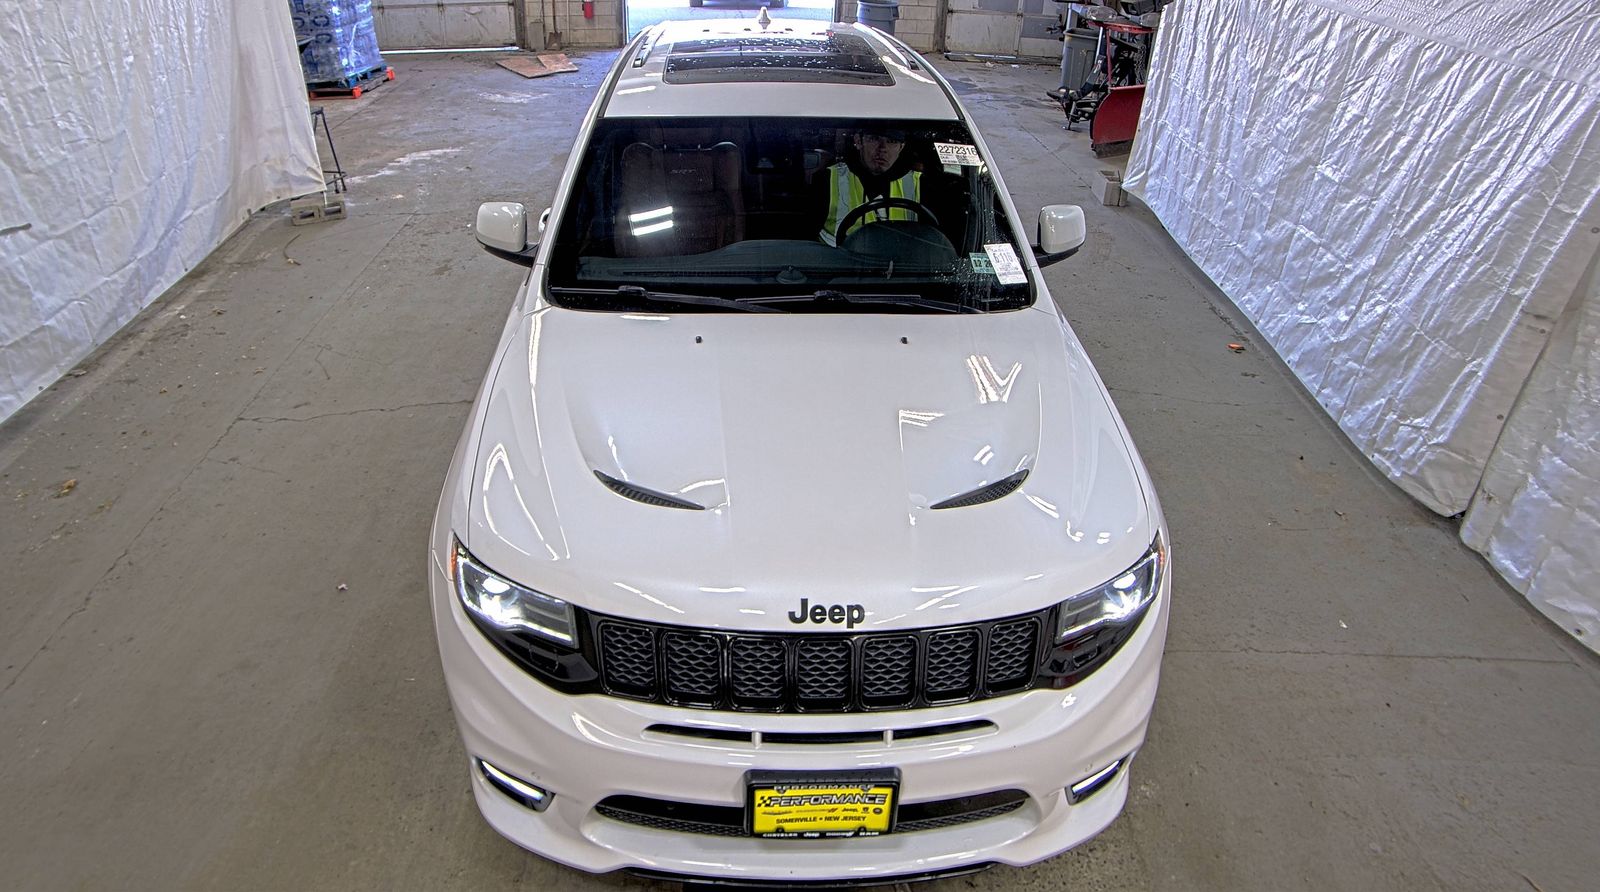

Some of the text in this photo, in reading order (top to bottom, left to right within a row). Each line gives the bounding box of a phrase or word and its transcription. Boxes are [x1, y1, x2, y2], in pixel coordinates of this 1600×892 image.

[788, 598, 865, 629] Jeep
[769, 794, 887, 806] PERFORMANCE
[776, 816, 818, 824] SOMERVILLE
